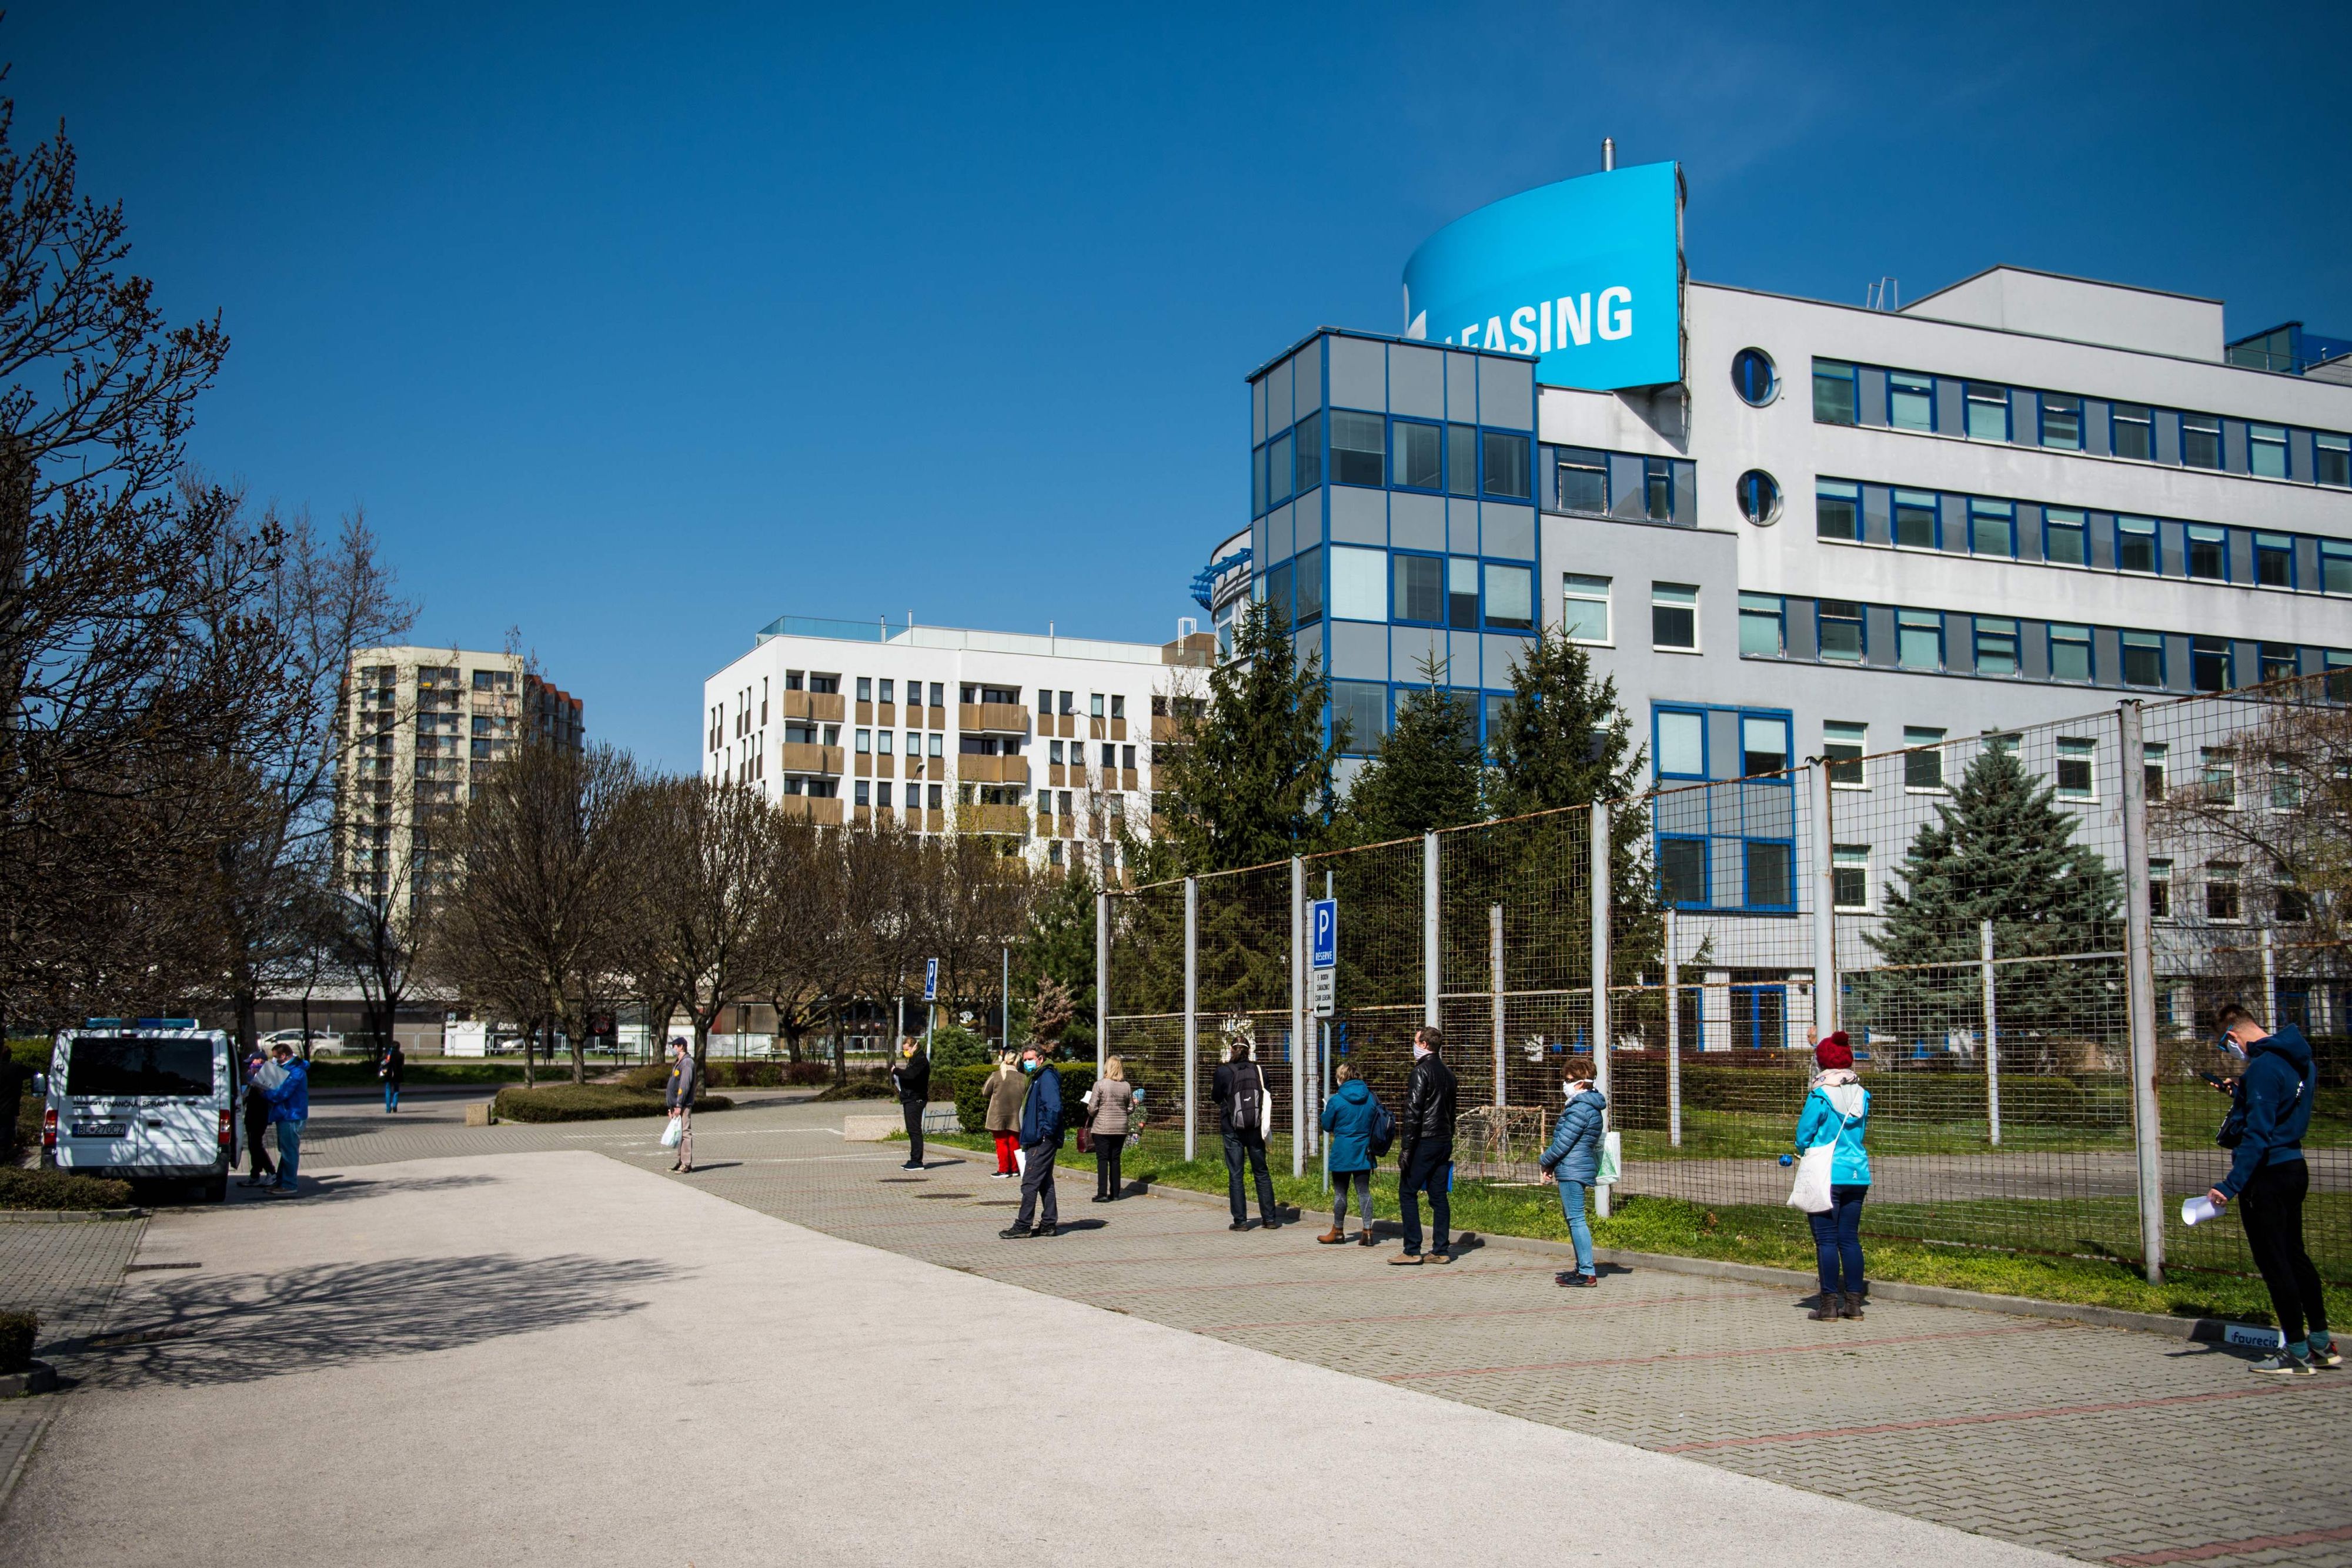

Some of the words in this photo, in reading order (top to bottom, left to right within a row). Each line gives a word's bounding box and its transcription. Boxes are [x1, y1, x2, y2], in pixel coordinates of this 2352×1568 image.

[1445, 286, 1632, 355] ASING
[1319, 909, 1329, 946] P
[928, 962, 934, 985] P
[103, 1099, 138, 1108] FINANČNÁ
[79, 1125, 90, 1134] BL
[2233, 1331, 2279, 1348] faurecia
